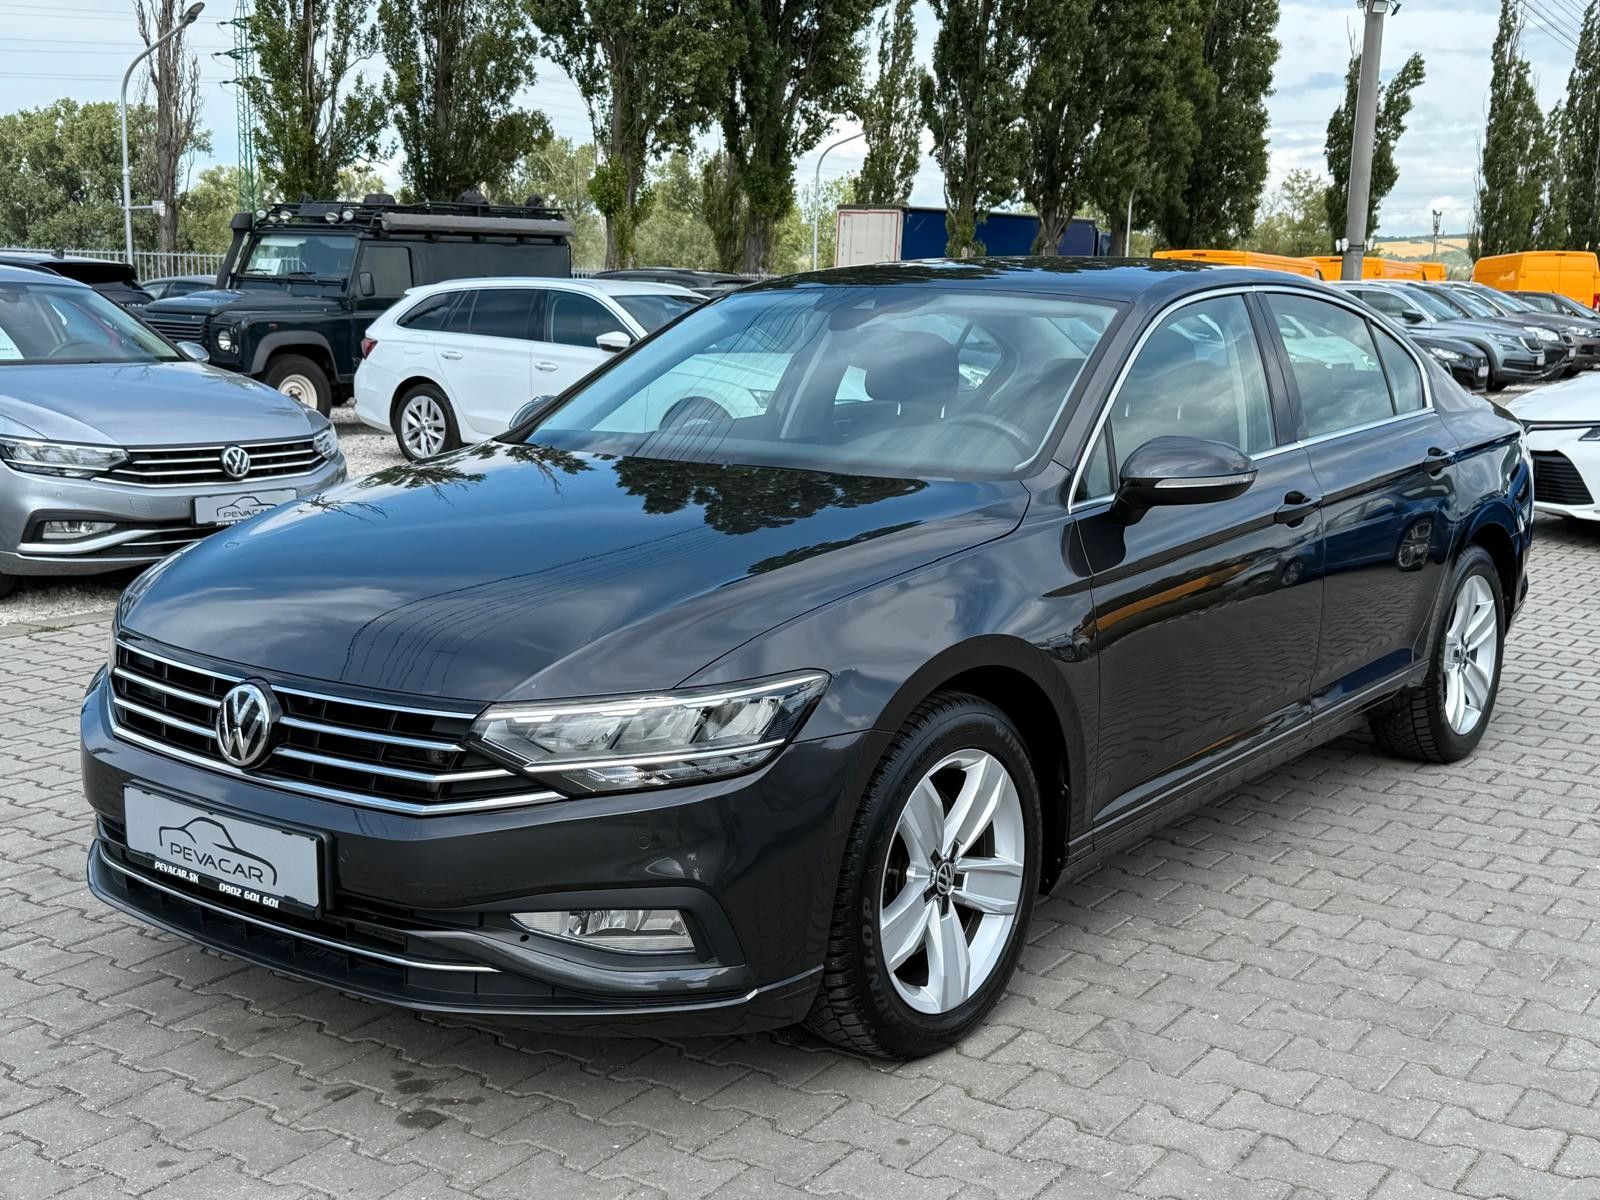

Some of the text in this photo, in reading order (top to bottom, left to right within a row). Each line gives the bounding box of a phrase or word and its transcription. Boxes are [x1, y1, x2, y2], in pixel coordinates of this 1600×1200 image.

[223, 508, 270, 518] PEVAC
[216, 684, 271, 767] VW
[154, 860, 279, 909] PEVACAR.SK 0902 601 601
[170, 842, 264, 883] PEVACAR
[862, 896, 899, 1022] DUNLOP
